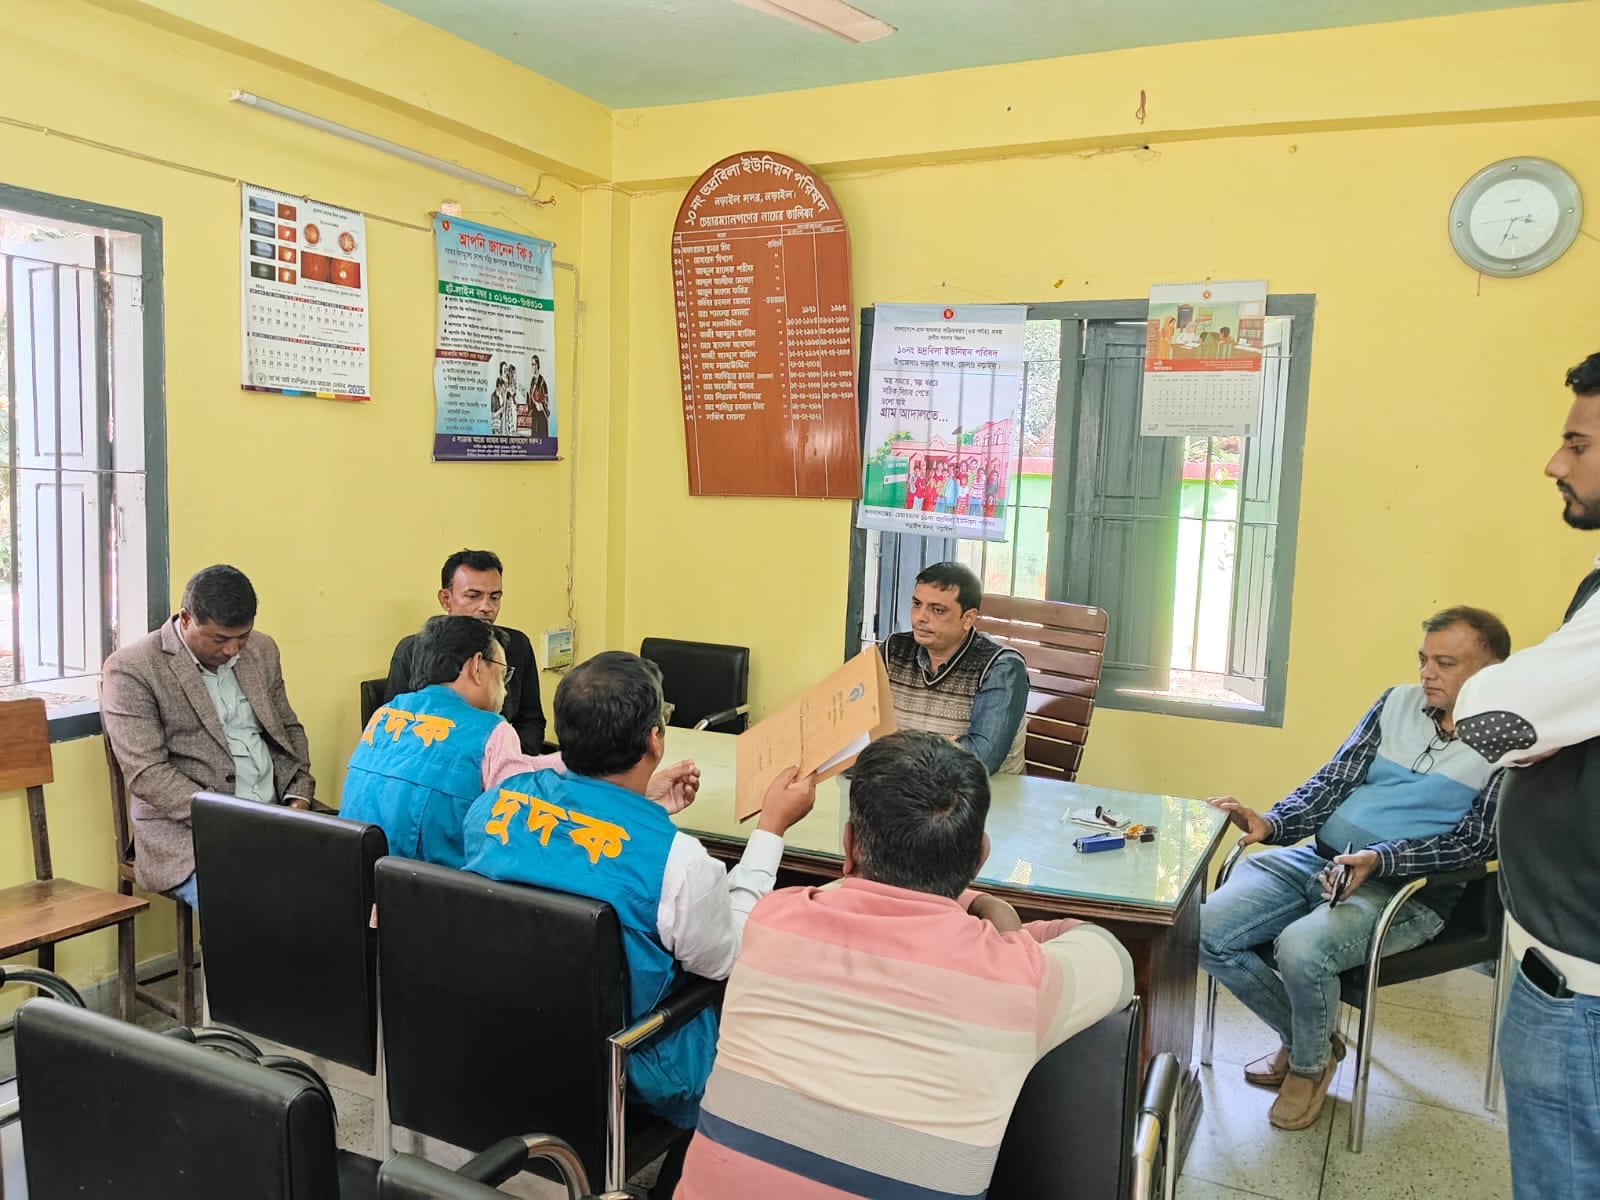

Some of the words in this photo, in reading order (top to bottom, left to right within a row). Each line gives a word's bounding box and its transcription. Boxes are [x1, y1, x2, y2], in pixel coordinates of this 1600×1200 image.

[699, 163, 741, 196] ভদ্রবিলা
[740, 155, 794, 180] ইউনিয়ন
[794, 173, 829, 212] পরিষদ
[714, 193, 740, 207] নড়াইল
[761, 210, 783, 222] নামের
[786, 205, 813, 219] তালিকা
[459, 233, 485, 249] আপনি
[488, 239, 514, 257] জানেন
[945, 344, 973, 357] ইউনিয়ন
[348, 387, 366, 395] 2025
[880, 407, 897, 417] গ্রাম
[485, 789, 631, 864] দুদক
